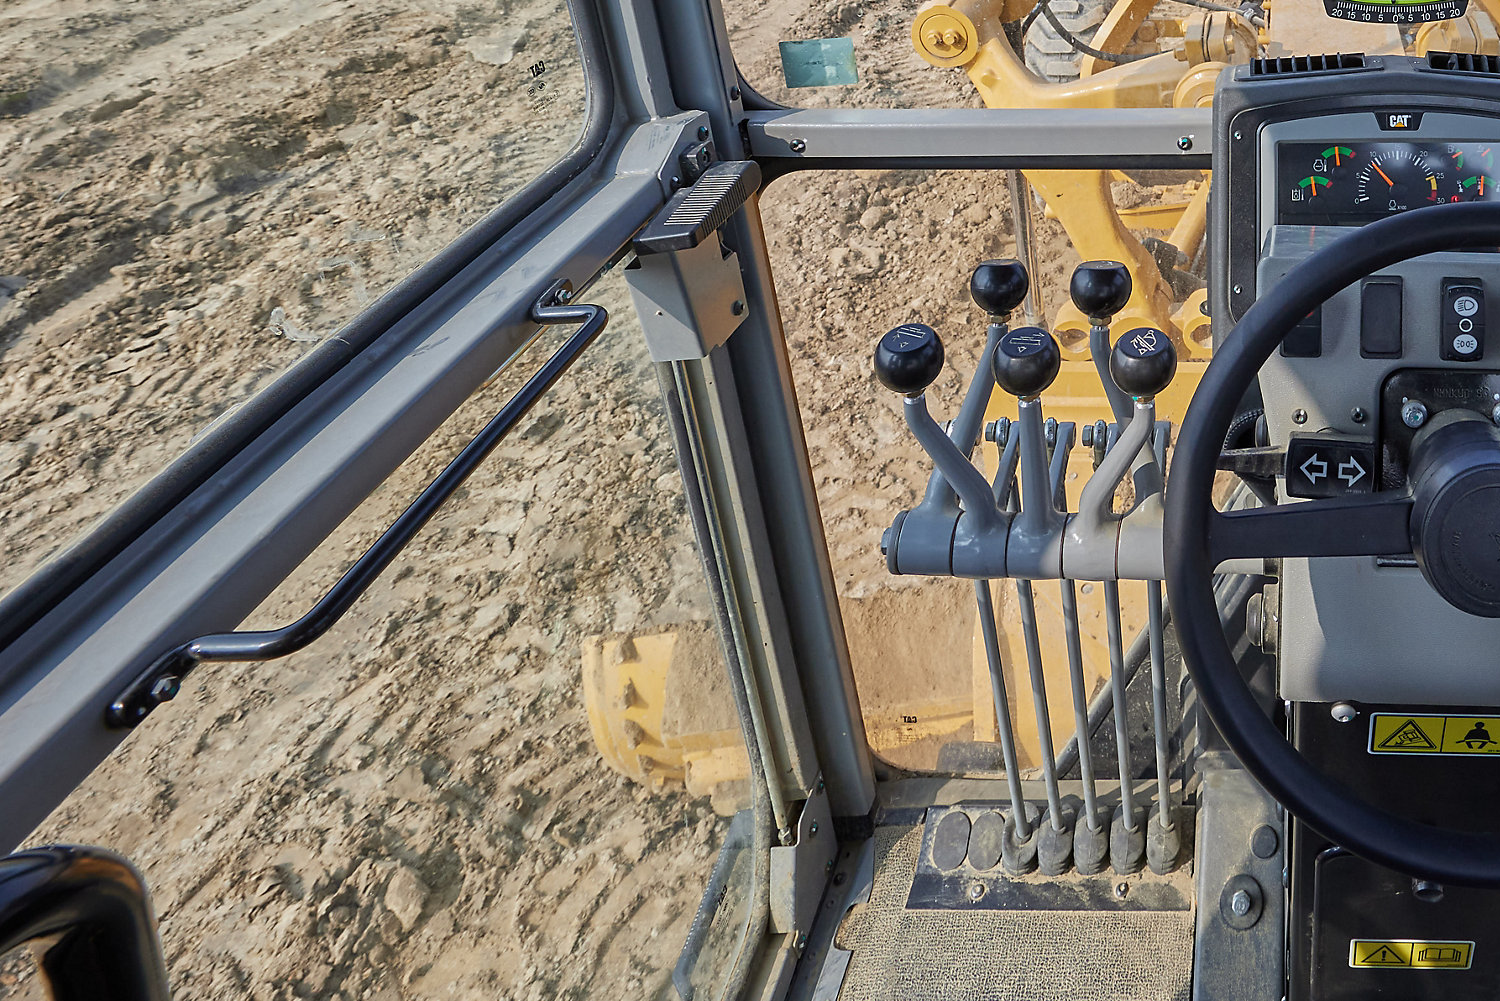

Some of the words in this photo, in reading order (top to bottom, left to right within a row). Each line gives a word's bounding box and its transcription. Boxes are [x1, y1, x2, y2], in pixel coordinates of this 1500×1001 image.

[1331, 8, 1343, 17] 20
[1346, 11, 1356, 20] 15
[1361, 13, 1371, 21] 10
[1377, 13, 1384, 22] 5
[1407, 13, 1414, 22] 5
[1420, 12, 1431, 21] 10
[1435, 11, 1446, 20] 15
[1449, 8, 1460, 17] 20
[1389, 115, 1409, 128] CAT
